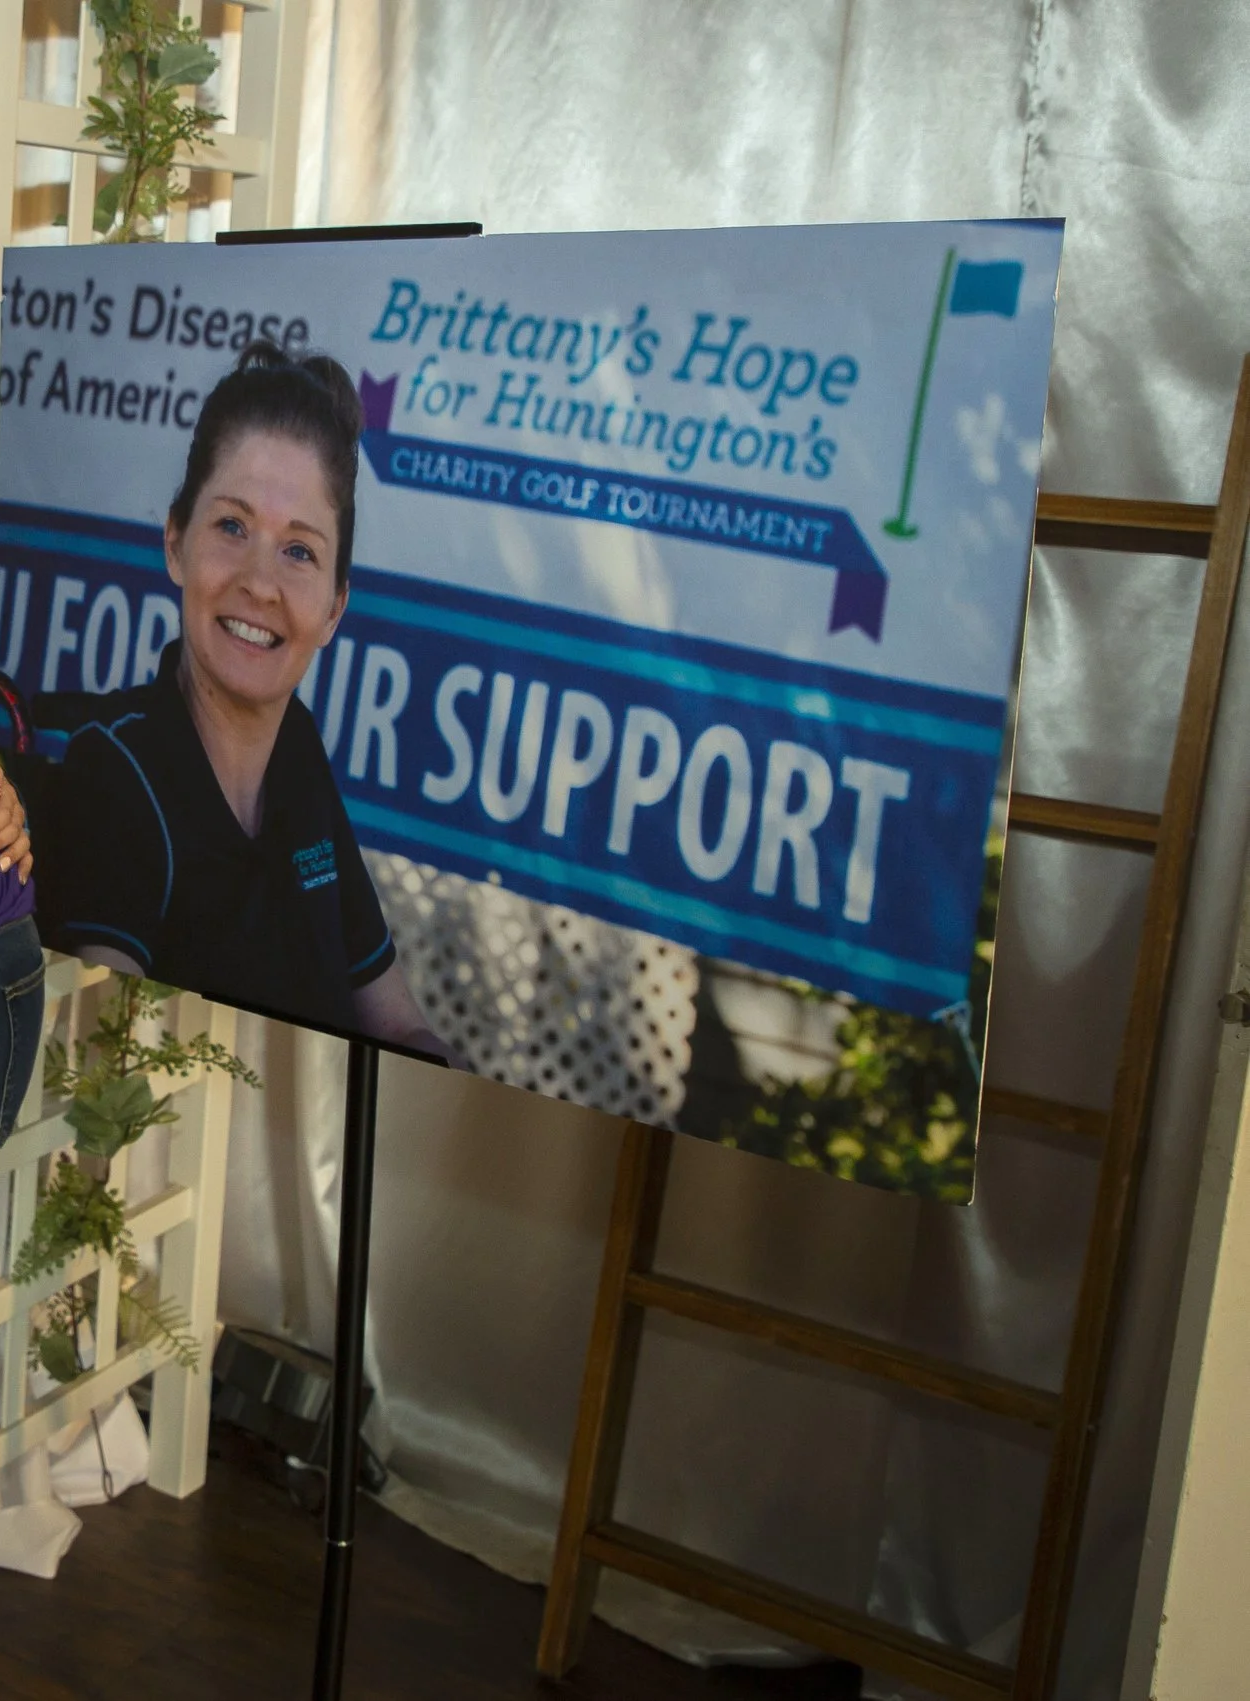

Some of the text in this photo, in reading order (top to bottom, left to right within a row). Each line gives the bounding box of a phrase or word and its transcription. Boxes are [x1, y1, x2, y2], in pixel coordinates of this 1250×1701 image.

[3, 276, 308, 351] ton's Disease
[370, 280, 860, 416] Brittany's Hope
[0, 350, 207, 428] of Americ
[405, 355, 838, 480] for Huntington's
[391, 447, 833, 553] CHARITY GOLF TOURNAMENT
[42, 576, 181, 694] FOR
[422, 664, 911, 925] SUPPORT
